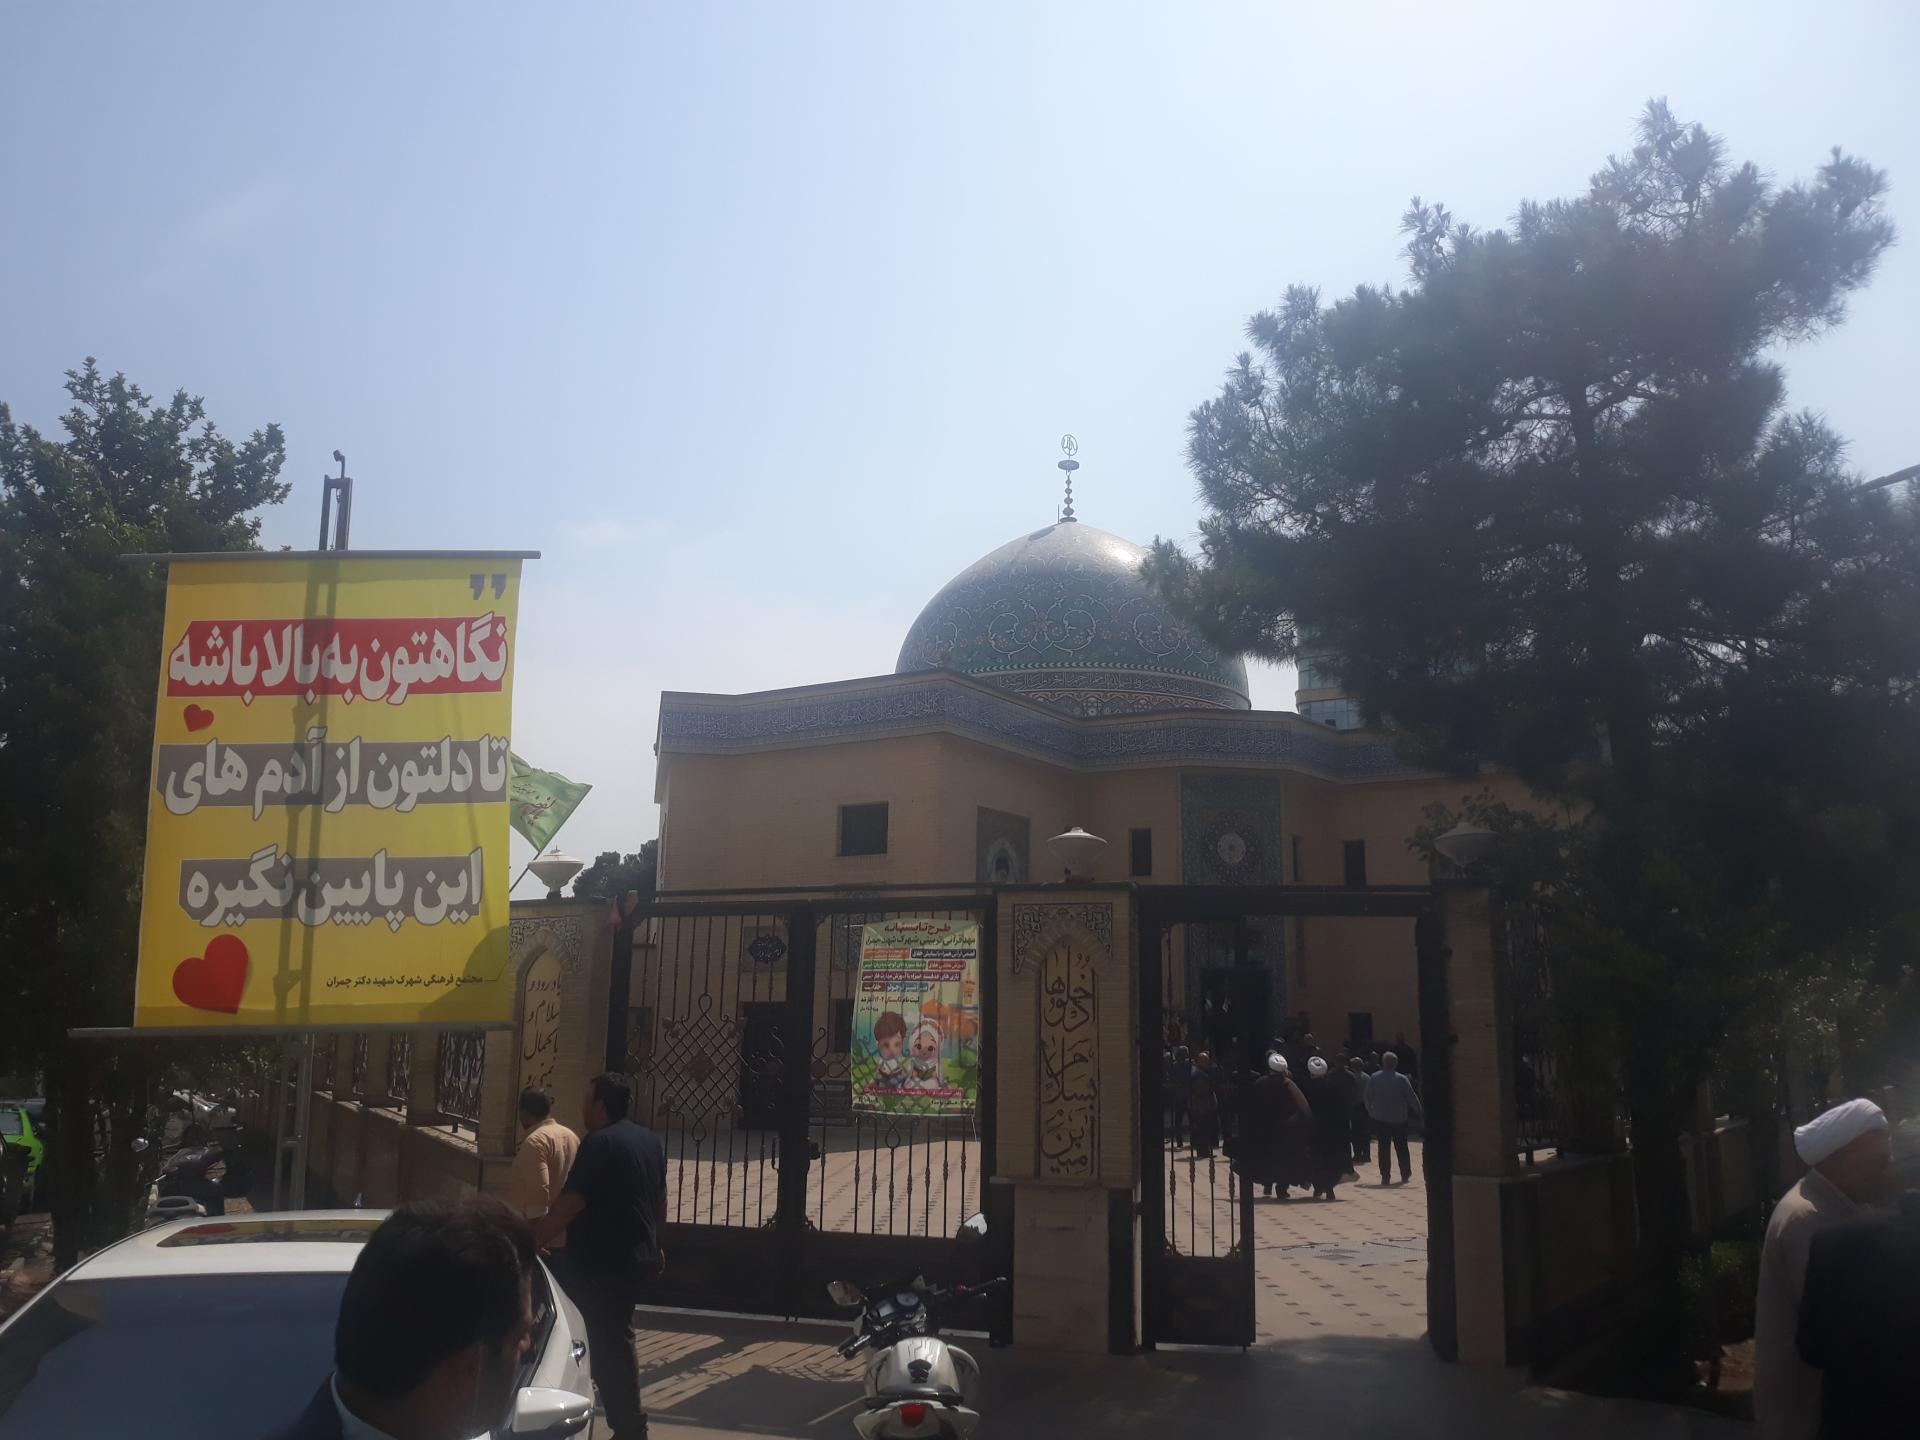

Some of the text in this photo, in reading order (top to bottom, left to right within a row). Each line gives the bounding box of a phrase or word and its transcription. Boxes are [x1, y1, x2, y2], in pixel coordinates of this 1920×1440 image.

[167, 611, 509, 706] نگاهتون به بالا باشه
[164, 725, 510, 821] تا دلتون از آدم های
[185, 842, 483, 933] این پایین نگیره
[326, 974, 483, 988] مجتمع فرهنگی شهرک شهید دکتر چمران
